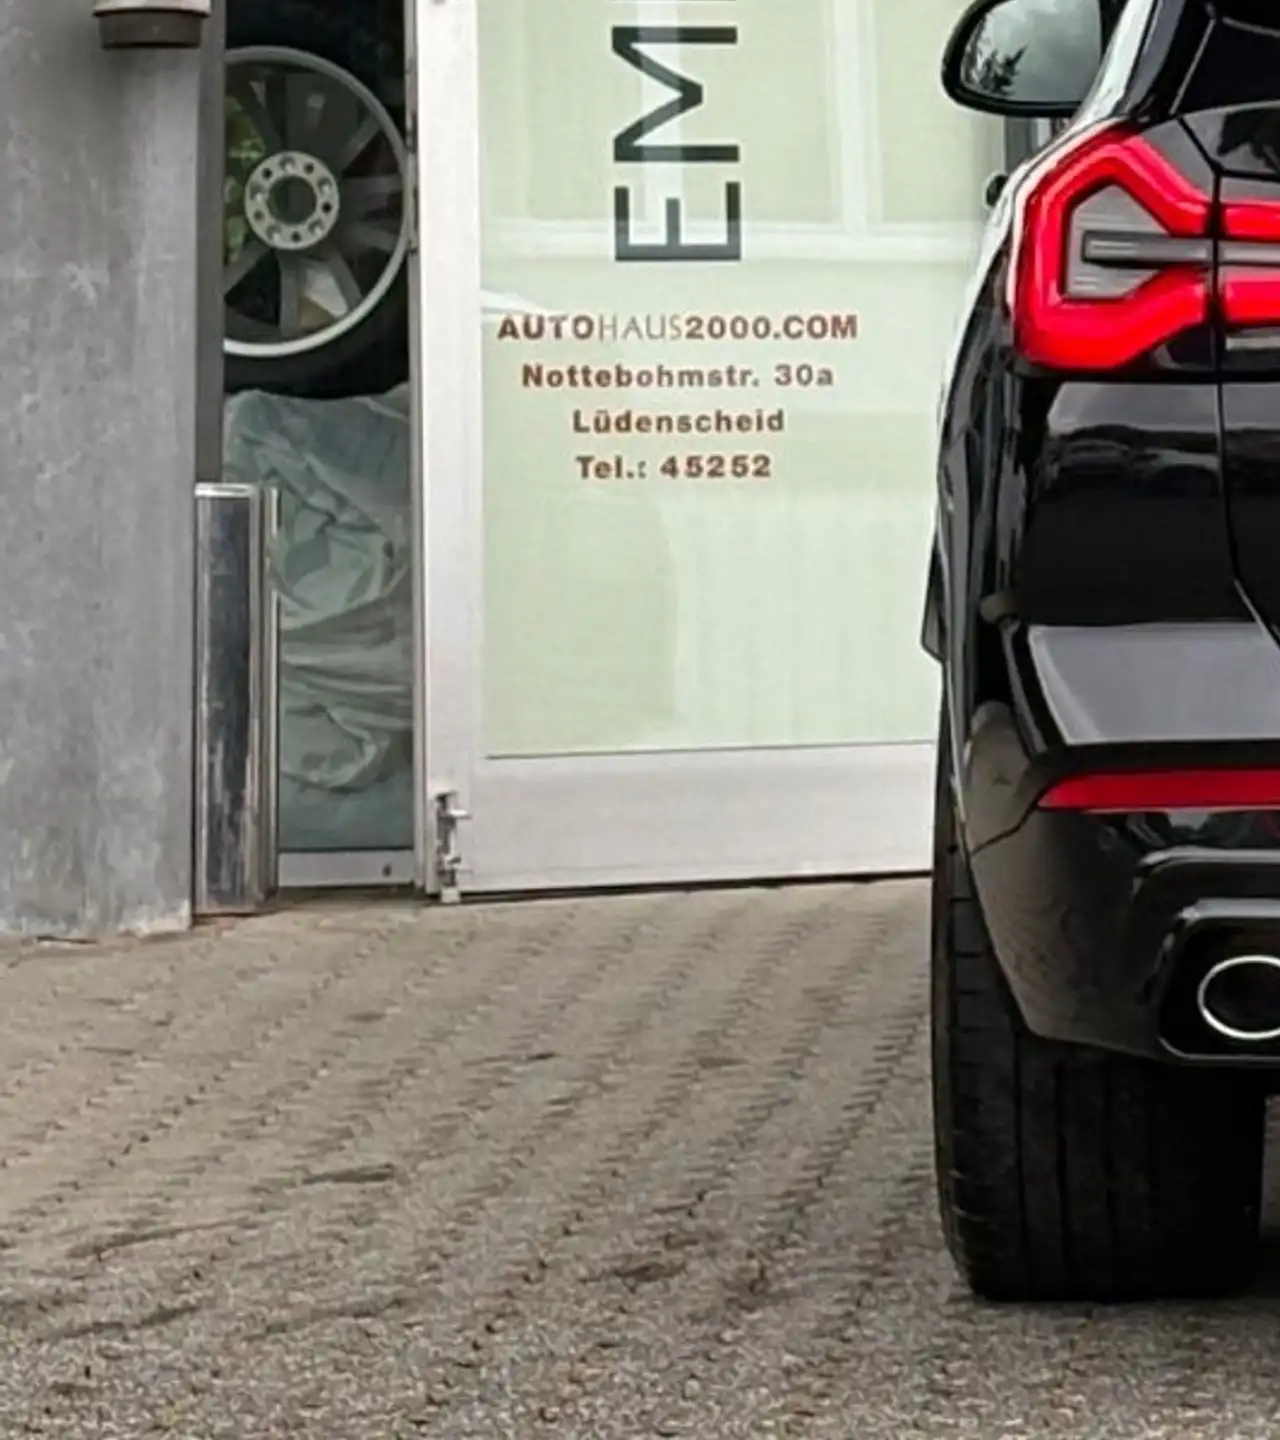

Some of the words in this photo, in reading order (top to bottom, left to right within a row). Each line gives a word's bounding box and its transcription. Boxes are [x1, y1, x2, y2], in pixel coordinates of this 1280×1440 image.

[497, 313, 858, 342] AUTOHAUS2000.COM
[522, 363, 760, 388] Nottebohmstr.
[774, 363, 834, 387] 30a
[573, 408, 785, 435] Lüdenscheid
[575, 455, 648, 480] Tel.:
[660, 455, 772, 479] 45252
